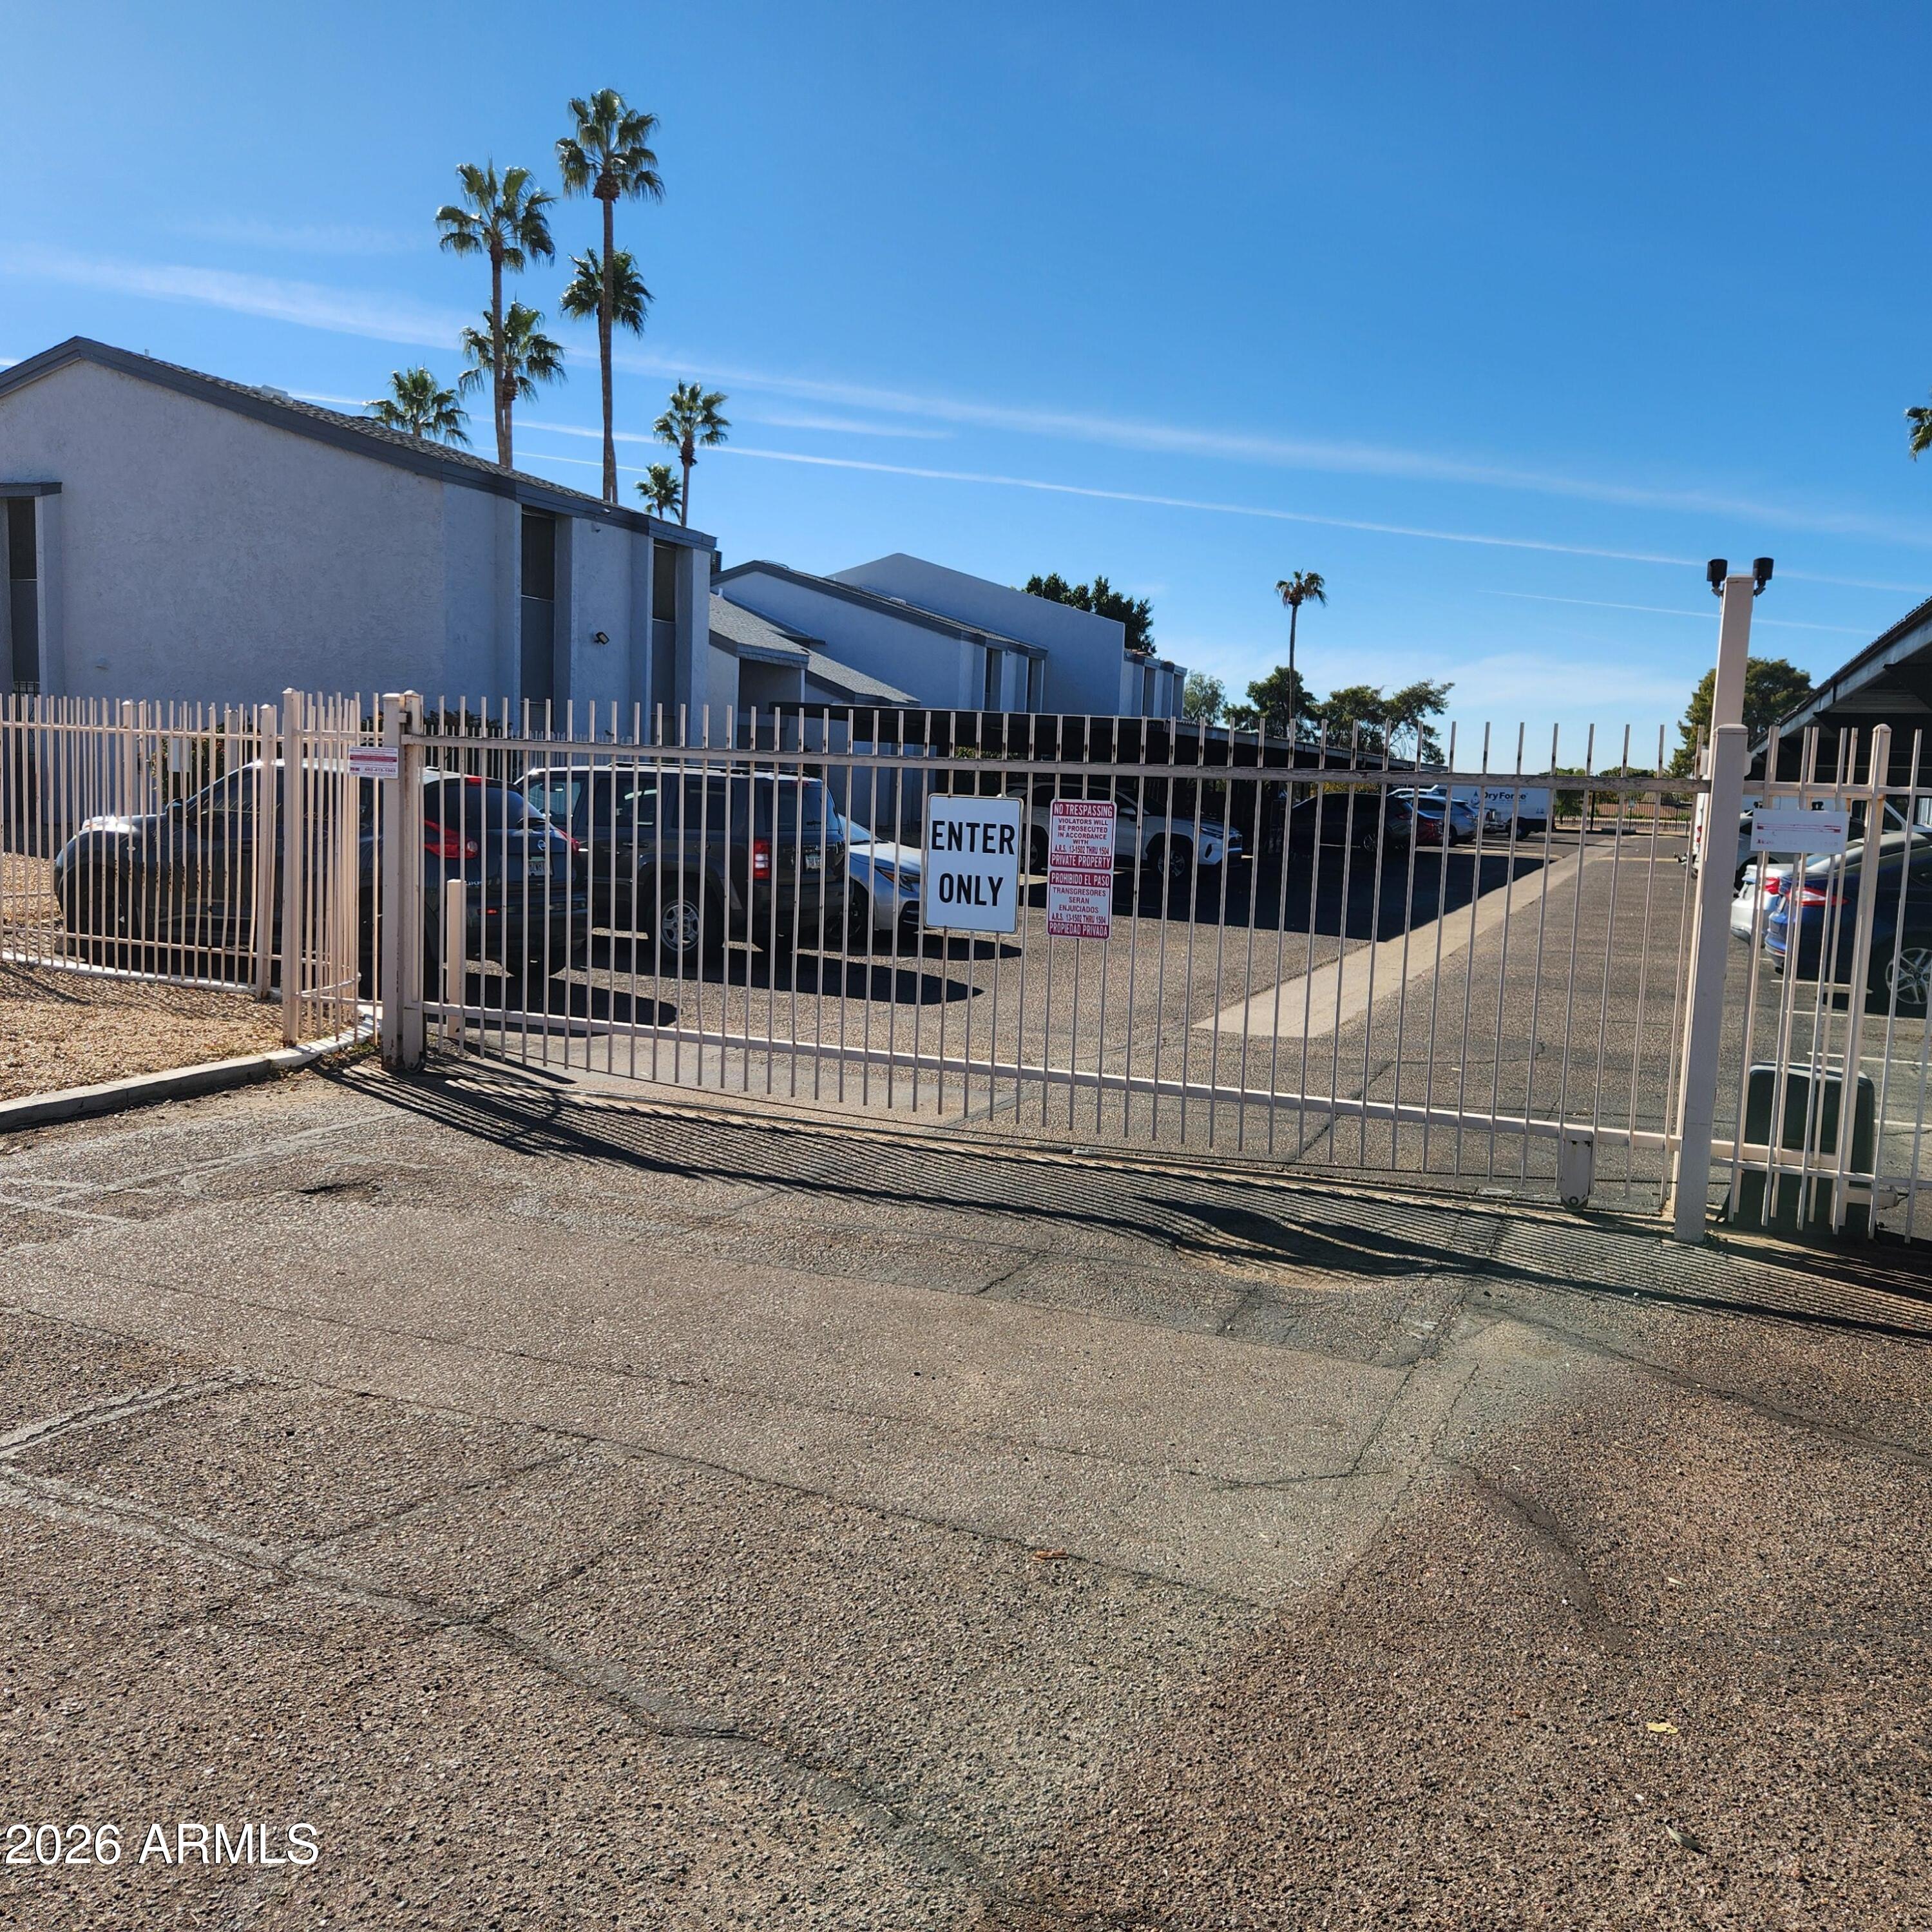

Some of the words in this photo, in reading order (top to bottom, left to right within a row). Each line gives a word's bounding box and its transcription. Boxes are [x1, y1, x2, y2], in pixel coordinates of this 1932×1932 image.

[1054, 803, 1064, 814] NO
[1066, 804, 1113, 817] TRESPASSING
[931, 820, 1015, 855] ENTER
[1069, 845, 1086, 854] 13-1502
[1099, 846, 1109, 855] 1504
[1051, 854, 1076, 866] PRIVATE
[1078, 856, 1111, 868] PROPERTY
[1051, 872, 1082, 885] PROHIBIDO
[1084, 874, 1091, 885] EL
[1093, 875, 1109, 886] PASO
[939, 873, 1004, 906] ONLY
[1053, 886, 1106, 897] TRANSGRESORES
[1059, 904, 1098, 913] ENJUICIADOS
[1066, 913, 1082, 923] 13-1502
[1083, 914, 1095, 923] THRU
[1096, 915, 1106, 924] 1504
[1049, 923, 1081, 935] PROPIEDAD
[1083, 925, 1107, 937] PRIVADA
